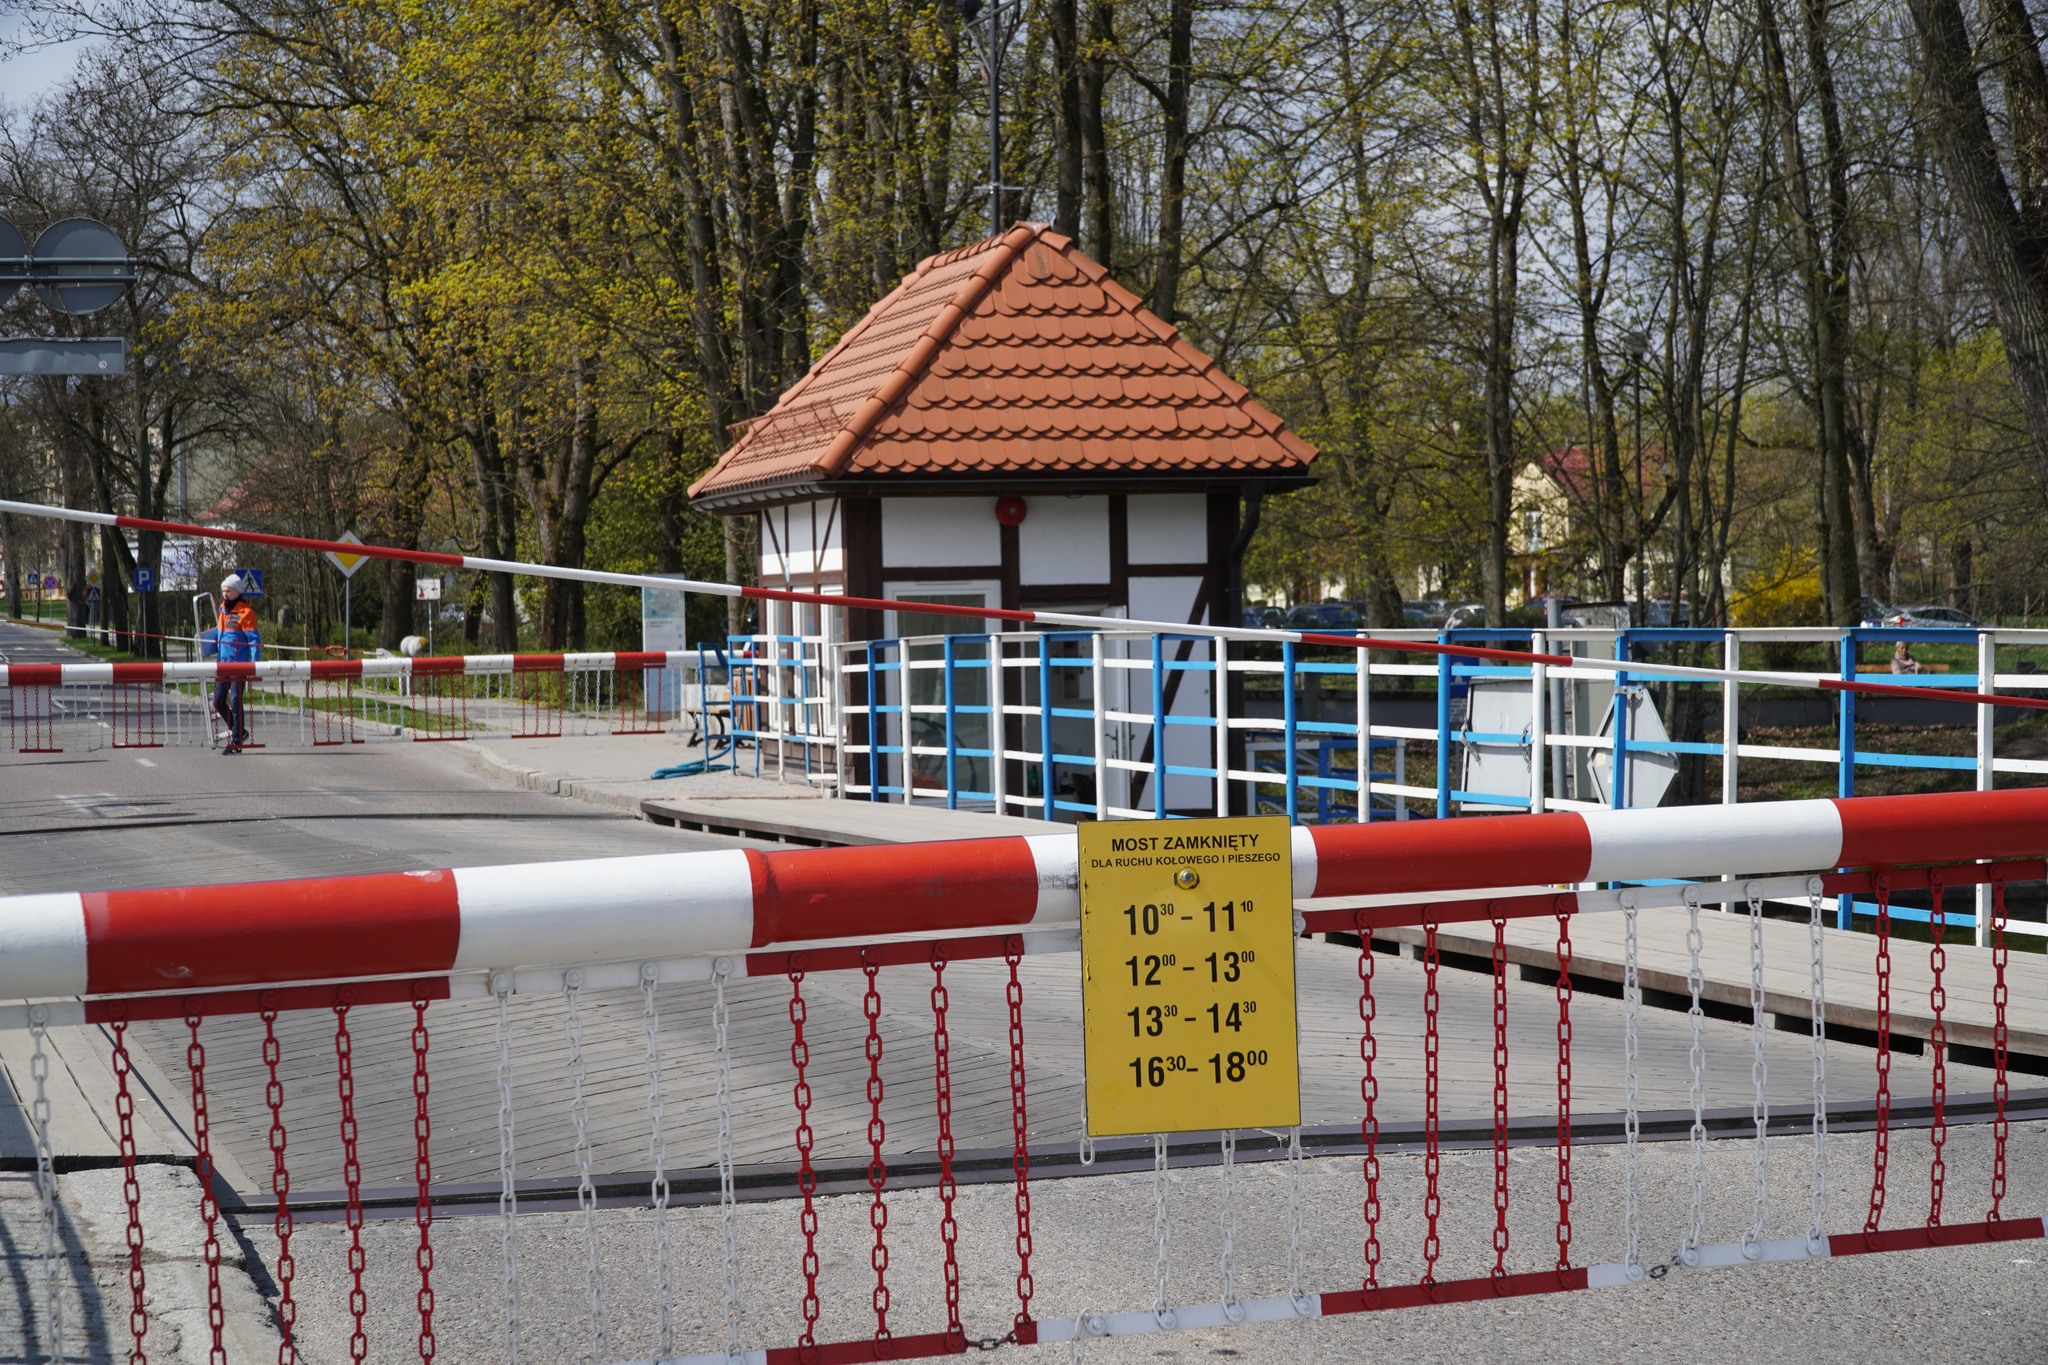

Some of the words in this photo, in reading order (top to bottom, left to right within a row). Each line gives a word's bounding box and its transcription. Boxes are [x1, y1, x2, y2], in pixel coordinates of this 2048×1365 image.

[138, 570, 149, 585] P
[1111, 837, 1159, 852] MOST
[1163, 833, 1259, 852] ZAMKNIĘTY
[1091, 858, 1113, 868] DLA
[1115, 857, 1153, 868] RUCHU
[1155, 855, 1221, 866] KOŁOWEGO
[1228, 852, 1281, 864] PIESZEGO
